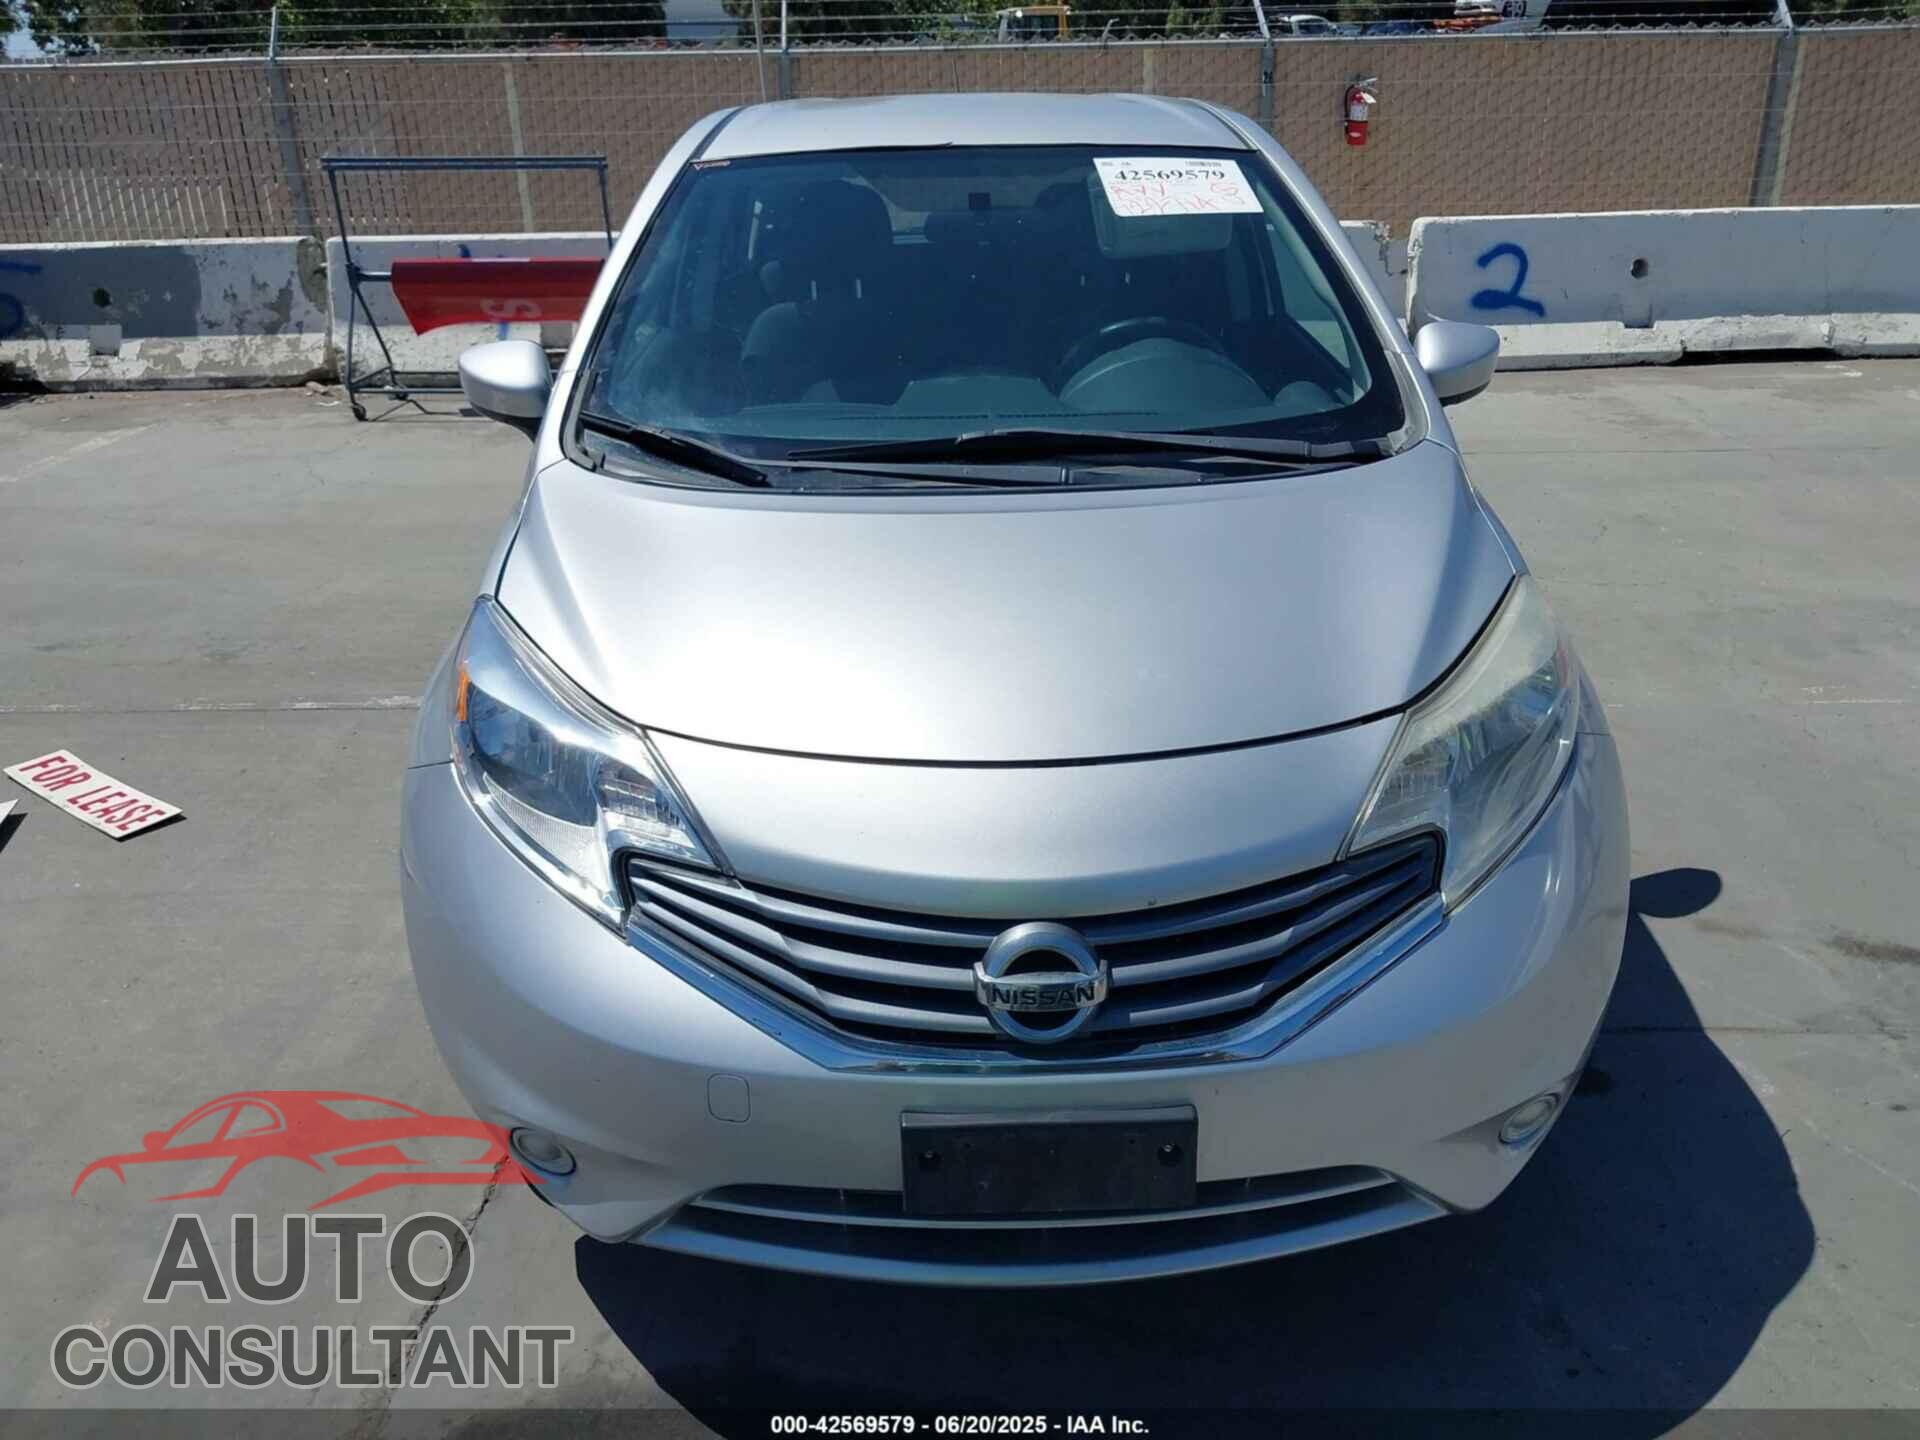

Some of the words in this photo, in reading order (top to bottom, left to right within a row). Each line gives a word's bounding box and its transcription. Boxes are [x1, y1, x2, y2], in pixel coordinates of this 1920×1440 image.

[1115, 169, 1225, 181] 42569579
[1471, 242, 1546, 318] 2
[18, 755, 92, 791] FOR
[66, 785, 166, 831] LEASE
[991, 982, 1096, 1009] NISSAN
